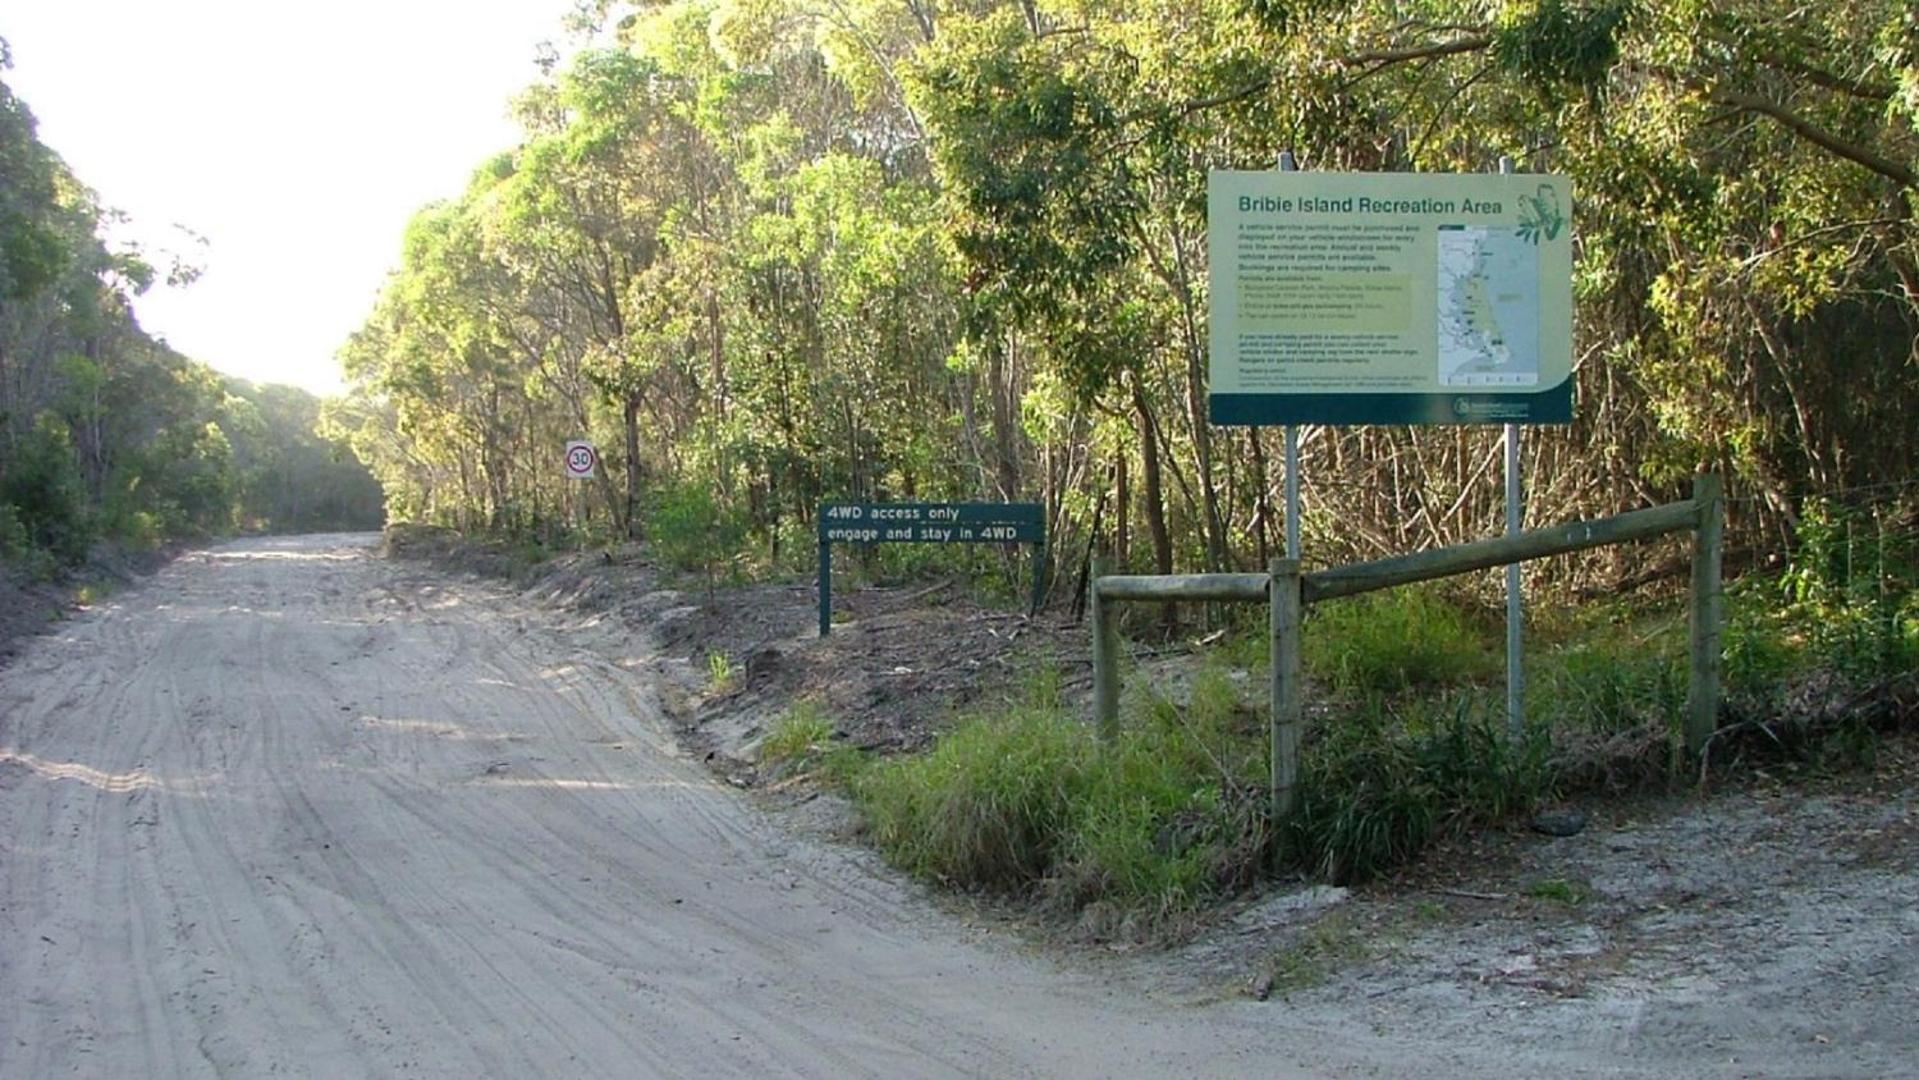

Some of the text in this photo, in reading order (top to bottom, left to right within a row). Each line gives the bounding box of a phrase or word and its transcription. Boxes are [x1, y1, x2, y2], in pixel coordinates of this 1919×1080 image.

[1238, 196, 1503, 214] Bribie Island Recreation Area
[573, 452, 588, 465] 30
[827, 506, 960, 521] 4WD access only
[827, 527, 1017, 541] engage and stay in 4WD
